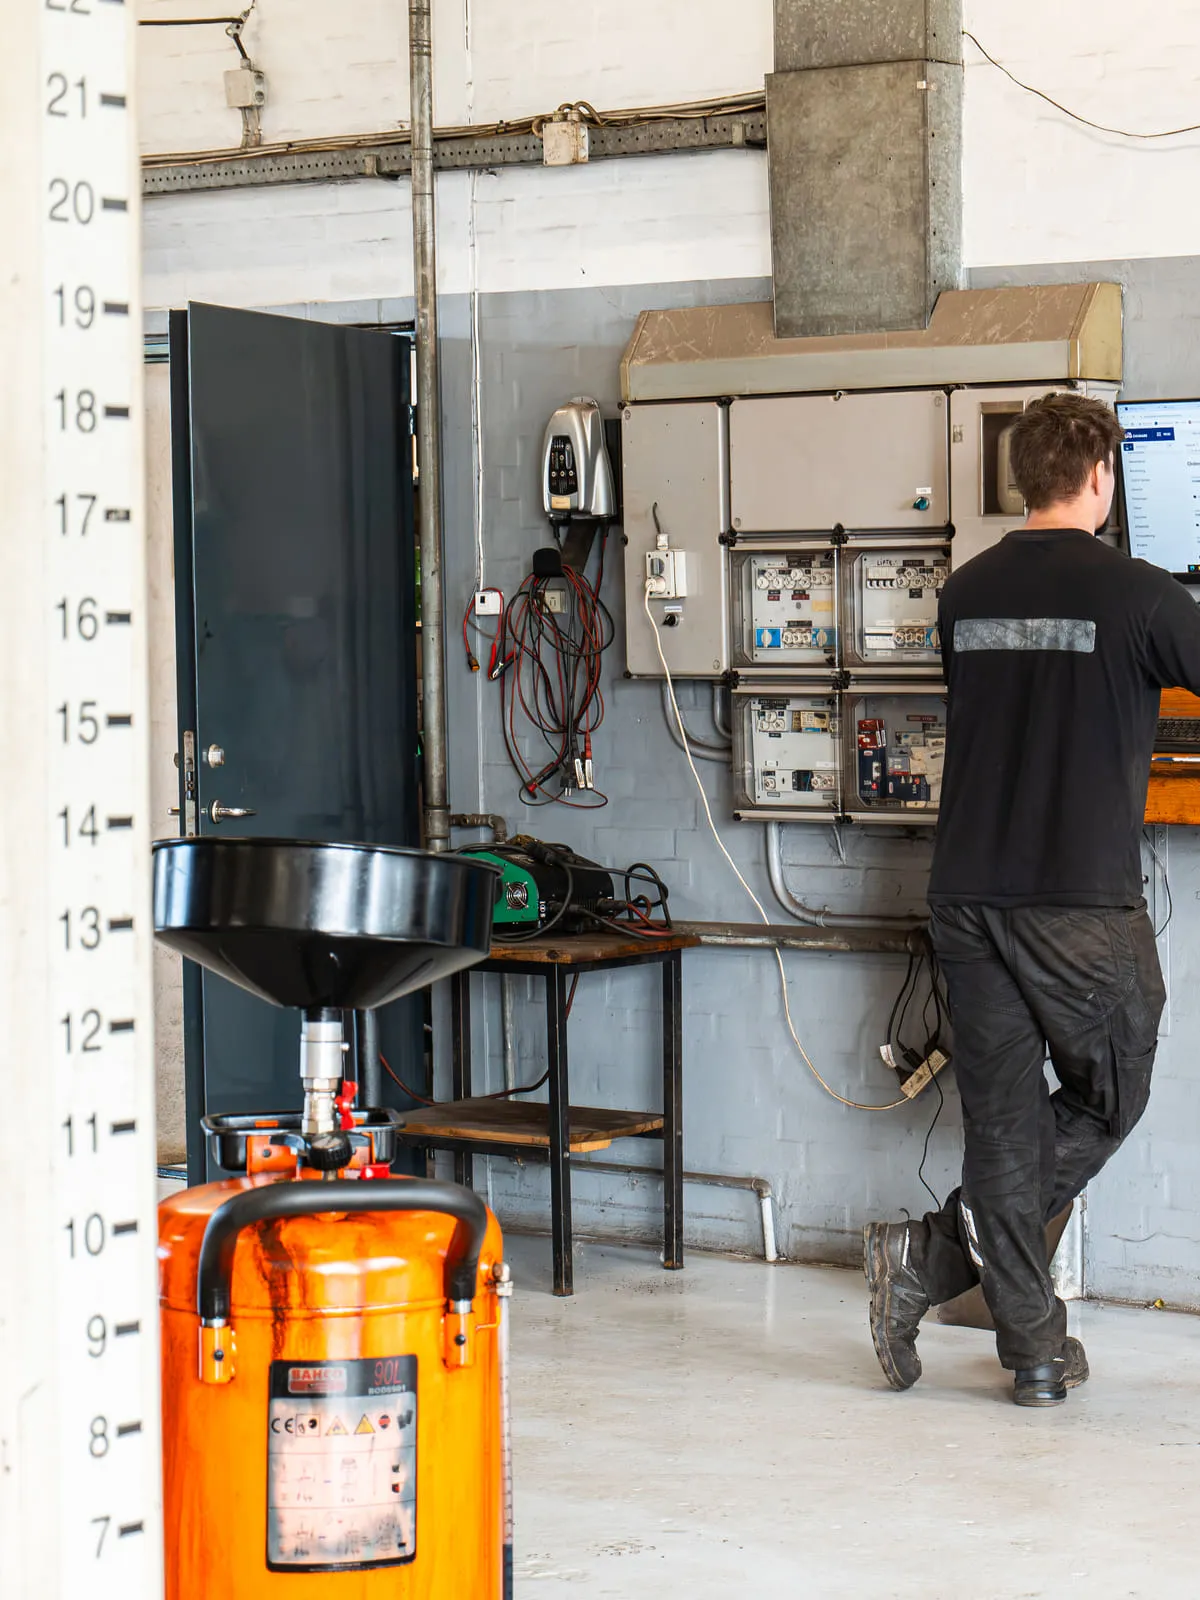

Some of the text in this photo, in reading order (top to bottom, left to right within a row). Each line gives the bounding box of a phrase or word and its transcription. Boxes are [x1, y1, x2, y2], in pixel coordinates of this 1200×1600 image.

[47, 73, 90, 118] 21
[48, 178, 95, 225] 20
[55, 285, 95, 329] 19
[55, 389, 96, 433] 18
[56, 494, 97, 536] 17
[57, 598, 98, 640] 16
[58, 701, 99, 745] 15
[59, 805, 99, 847] 14
[60, 907, 101, 950] 13
[62, 1009, 101, 1053] 12
[63, 1112, 98, 1156] 11
[66, 1213, 105, 1257] 10
[87, 1314, 107, 1358] 9
[291, 1367, 344, 1380] BAHCO
[374, 1359, 403, 1386] 90L
[89, 1416, 109, 1459] 8
[91, 1516, 111, 1558] 7
